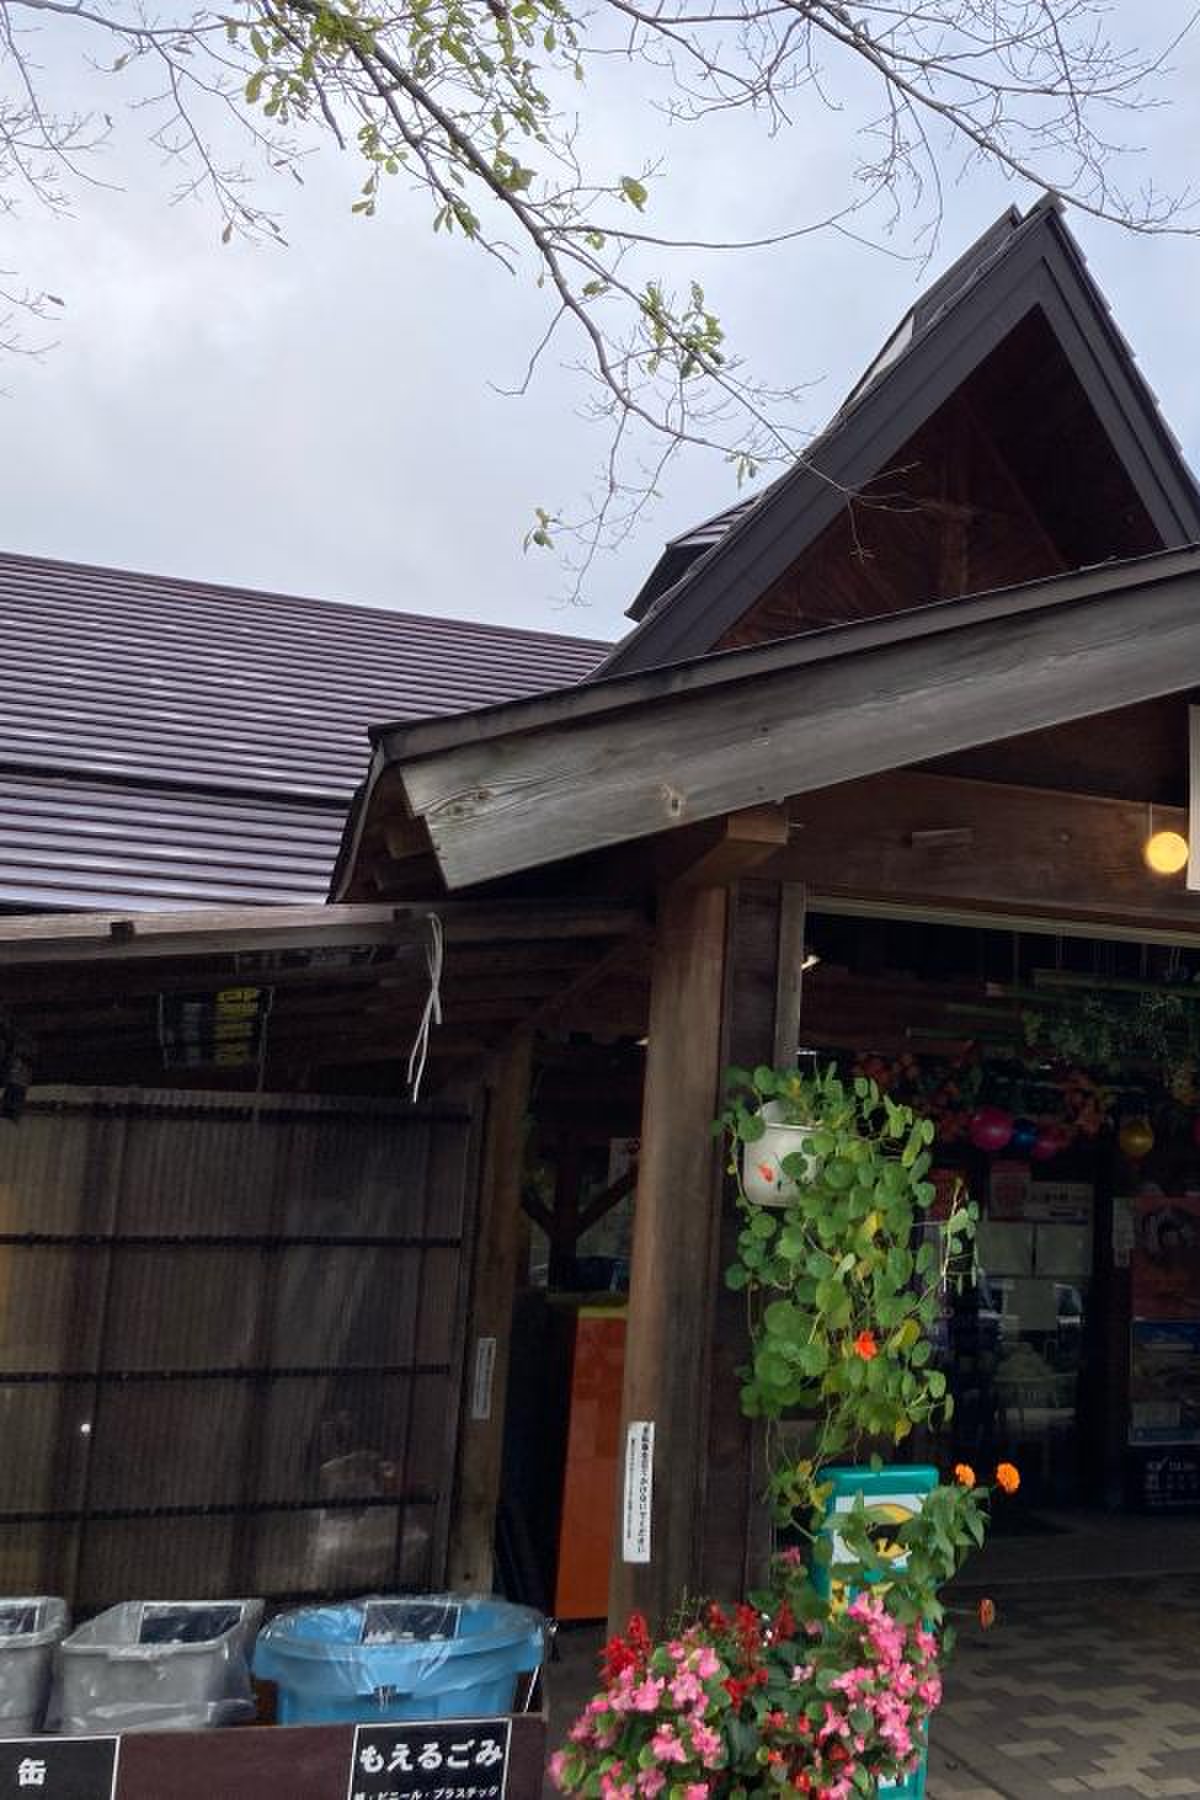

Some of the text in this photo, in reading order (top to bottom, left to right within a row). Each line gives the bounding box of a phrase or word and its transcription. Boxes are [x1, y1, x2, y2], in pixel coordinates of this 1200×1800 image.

[360, 1739, 504, 1773] もえるごみ
[18, 1758, 47, 1787] 缶
